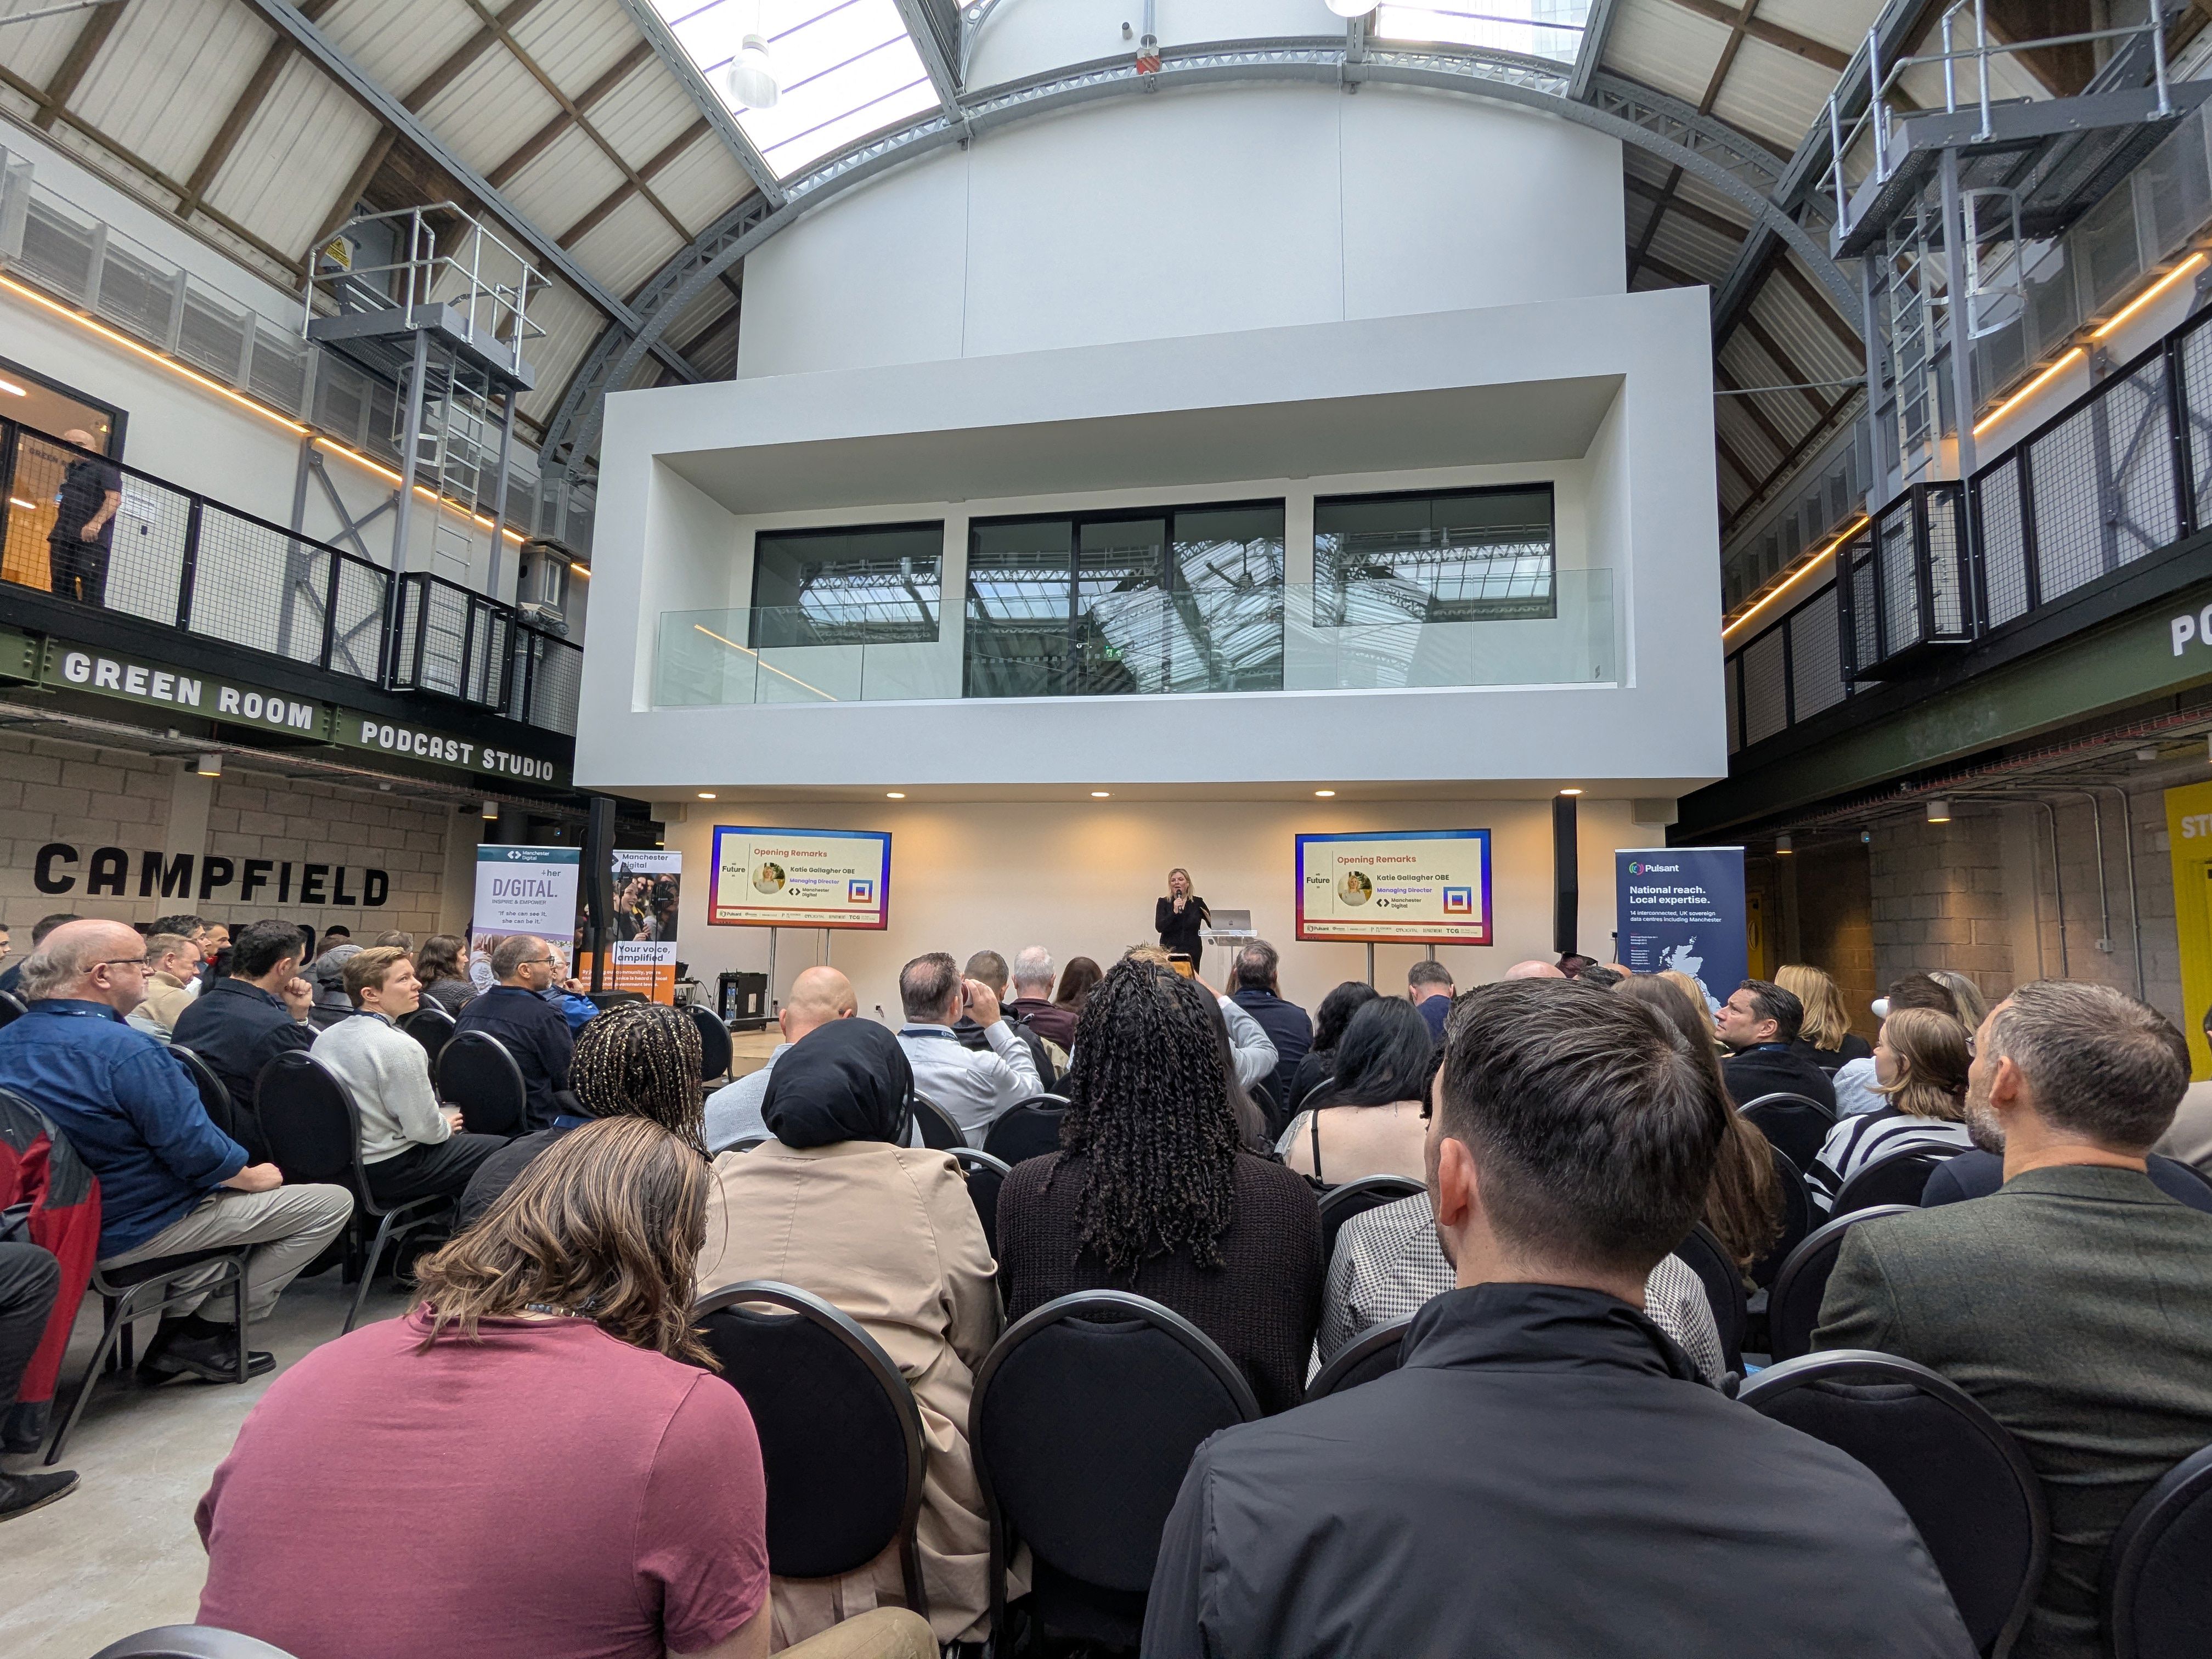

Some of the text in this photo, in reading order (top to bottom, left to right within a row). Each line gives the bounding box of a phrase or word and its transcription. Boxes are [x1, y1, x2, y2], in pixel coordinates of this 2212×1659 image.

[64, 652, 313, 730] GREEN ROOM
[362, 721, 553, 781] PODCAST STUDIO
[754, 849, 789, 857] Opening
[1337, 856, 1374, 865] Opening
[34, 842, 390, 907] CAMPFIELD
[1629, 885, 1706, 894] National reach.
[1658, 895, 1711, 905] expertise.
[618, 953, 663, 963] amplified
